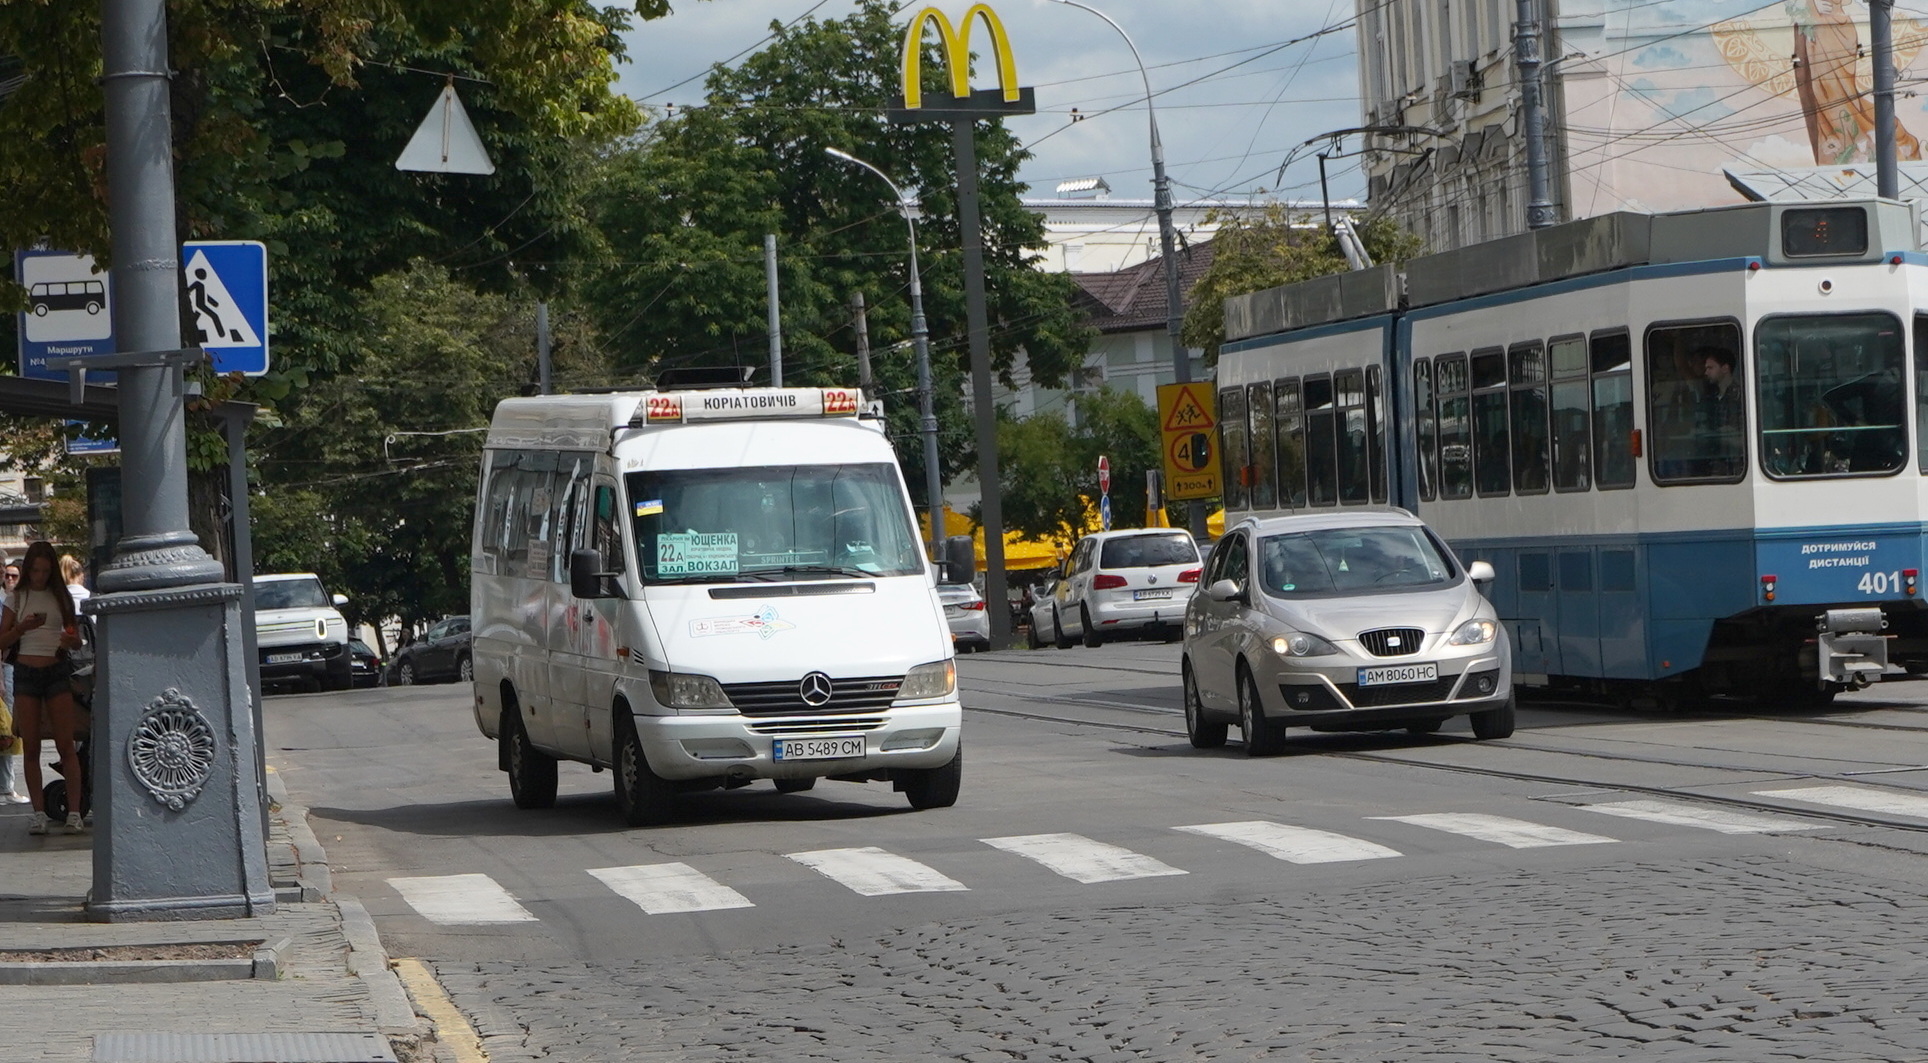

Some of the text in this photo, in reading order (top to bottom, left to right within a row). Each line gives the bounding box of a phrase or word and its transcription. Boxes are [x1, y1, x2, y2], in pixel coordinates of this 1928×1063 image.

[47, 345, 93, 356] Маршрути
[704, 394, 796, 410] КОРІАТОВИЧІВ
[1178, 443, 1191, 461] 4
[691, 534, 737, 548] ЮЩЕНКА
[1801, 541, 1876, 554] ДОТРИМУЙСЯ
[688, 560, 737, 572] ВОКЗАЛ
[761, 555, 801, 564] SPRINTER
[1808, 555, 1870, 569] ДИСТАНЦІЇ
[1857, 570, 1900, 594] 401
[1367, 666, 1434, 683] AM 8060 HC
[785, 740, 861, 757] AB 5489 CM
